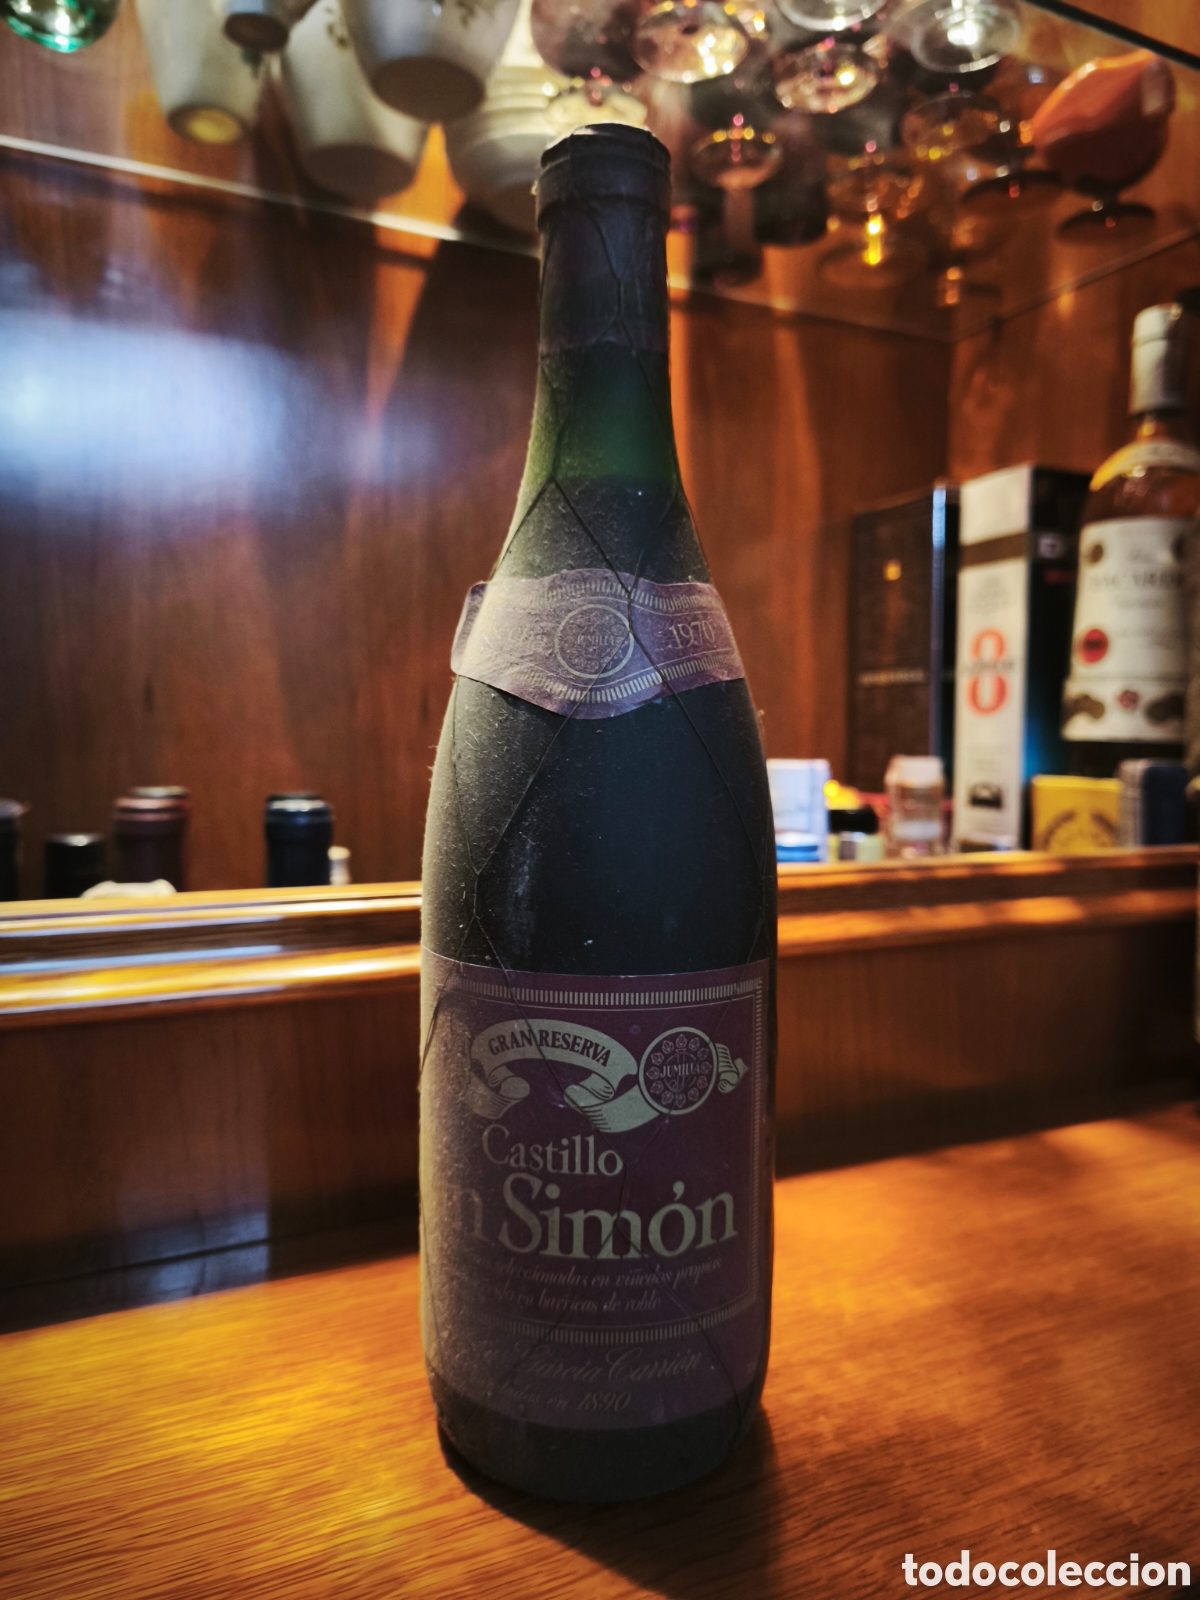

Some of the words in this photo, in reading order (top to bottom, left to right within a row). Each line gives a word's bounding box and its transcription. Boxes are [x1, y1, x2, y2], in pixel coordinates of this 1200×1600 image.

[669, 620, 716, 649] 1970
[488, 1029, 533, 1056] GRAN
[538, 1029, 611, 1067] RESERVA
[482, 1124, 624, 1176] Castillo
[498, 1172, 739, 1259] Simón
[578, 1390, 632, 1413] 1890
